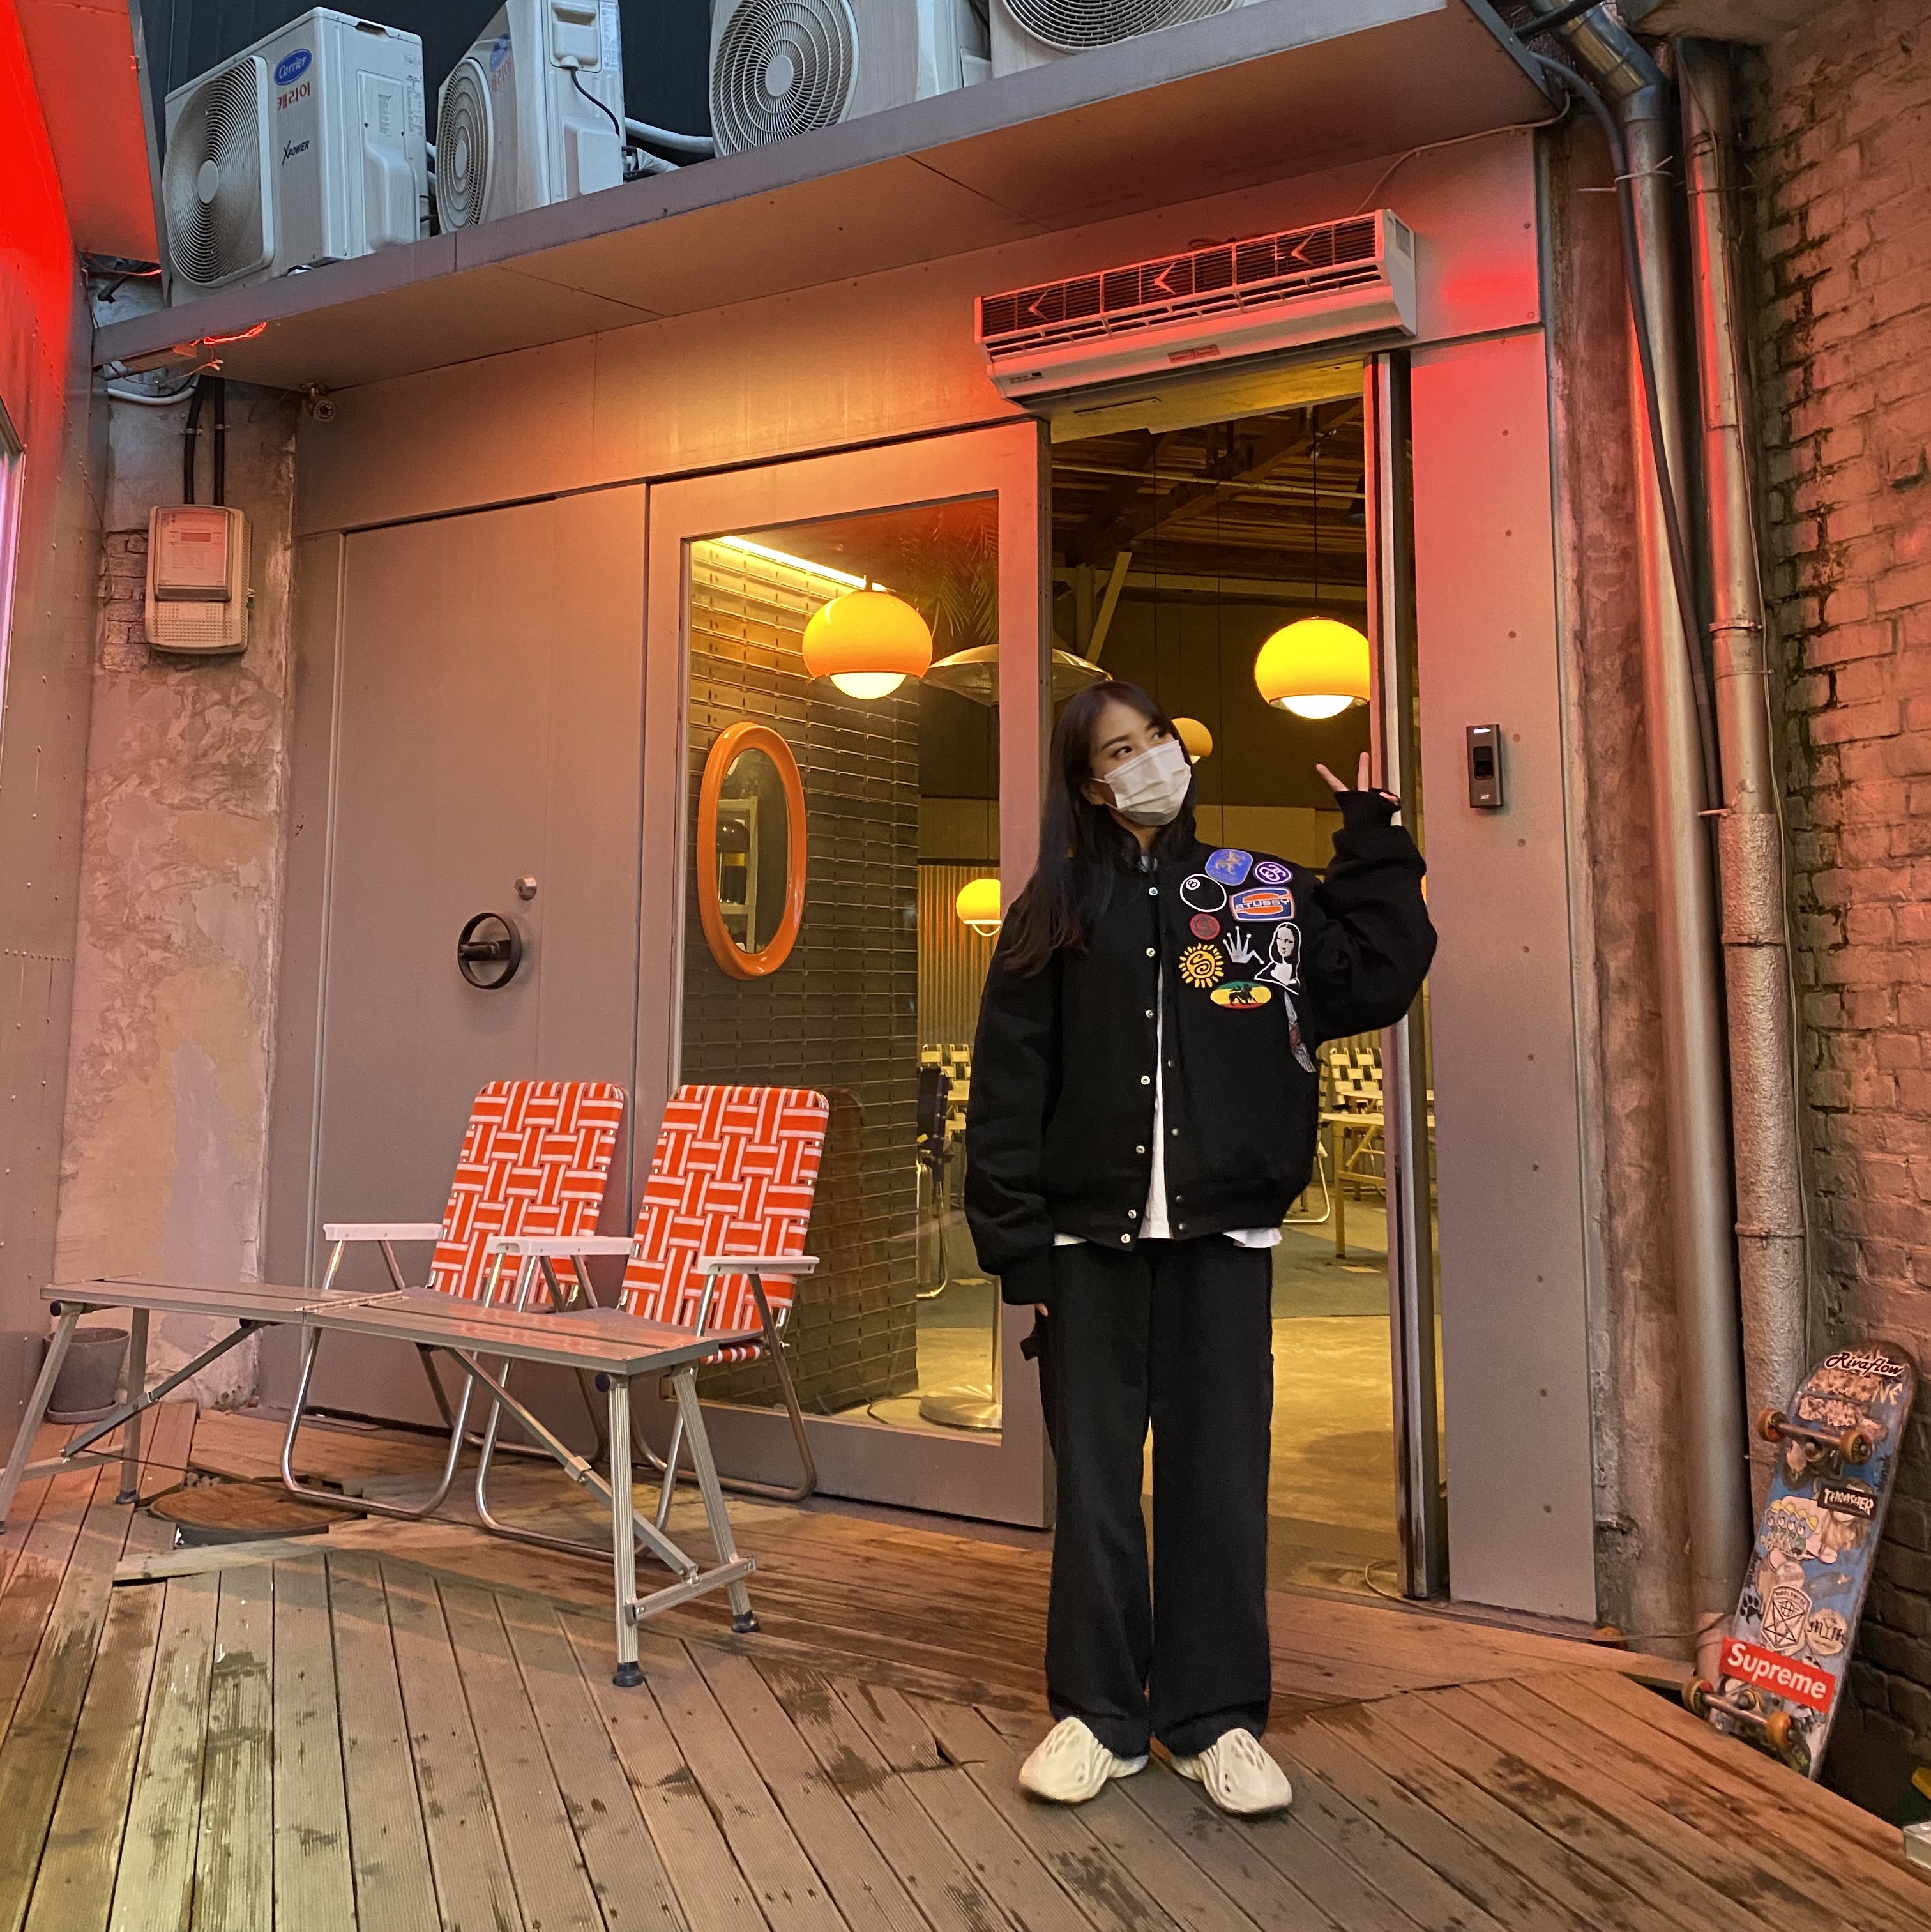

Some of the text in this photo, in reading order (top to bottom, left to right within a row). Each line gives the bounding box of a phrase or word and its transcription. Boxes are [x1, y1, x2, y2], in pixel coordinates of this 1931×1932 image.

[278, 56, 307, 79] Carrier
[1235, 899, 1290, 909] STUSSY
[1826, 1351, 1905, 1376] Rivaflow
[1824, 1488, 1875, 1516] THRASHER
[1727, 1643, 1827, 1700] Supreme
